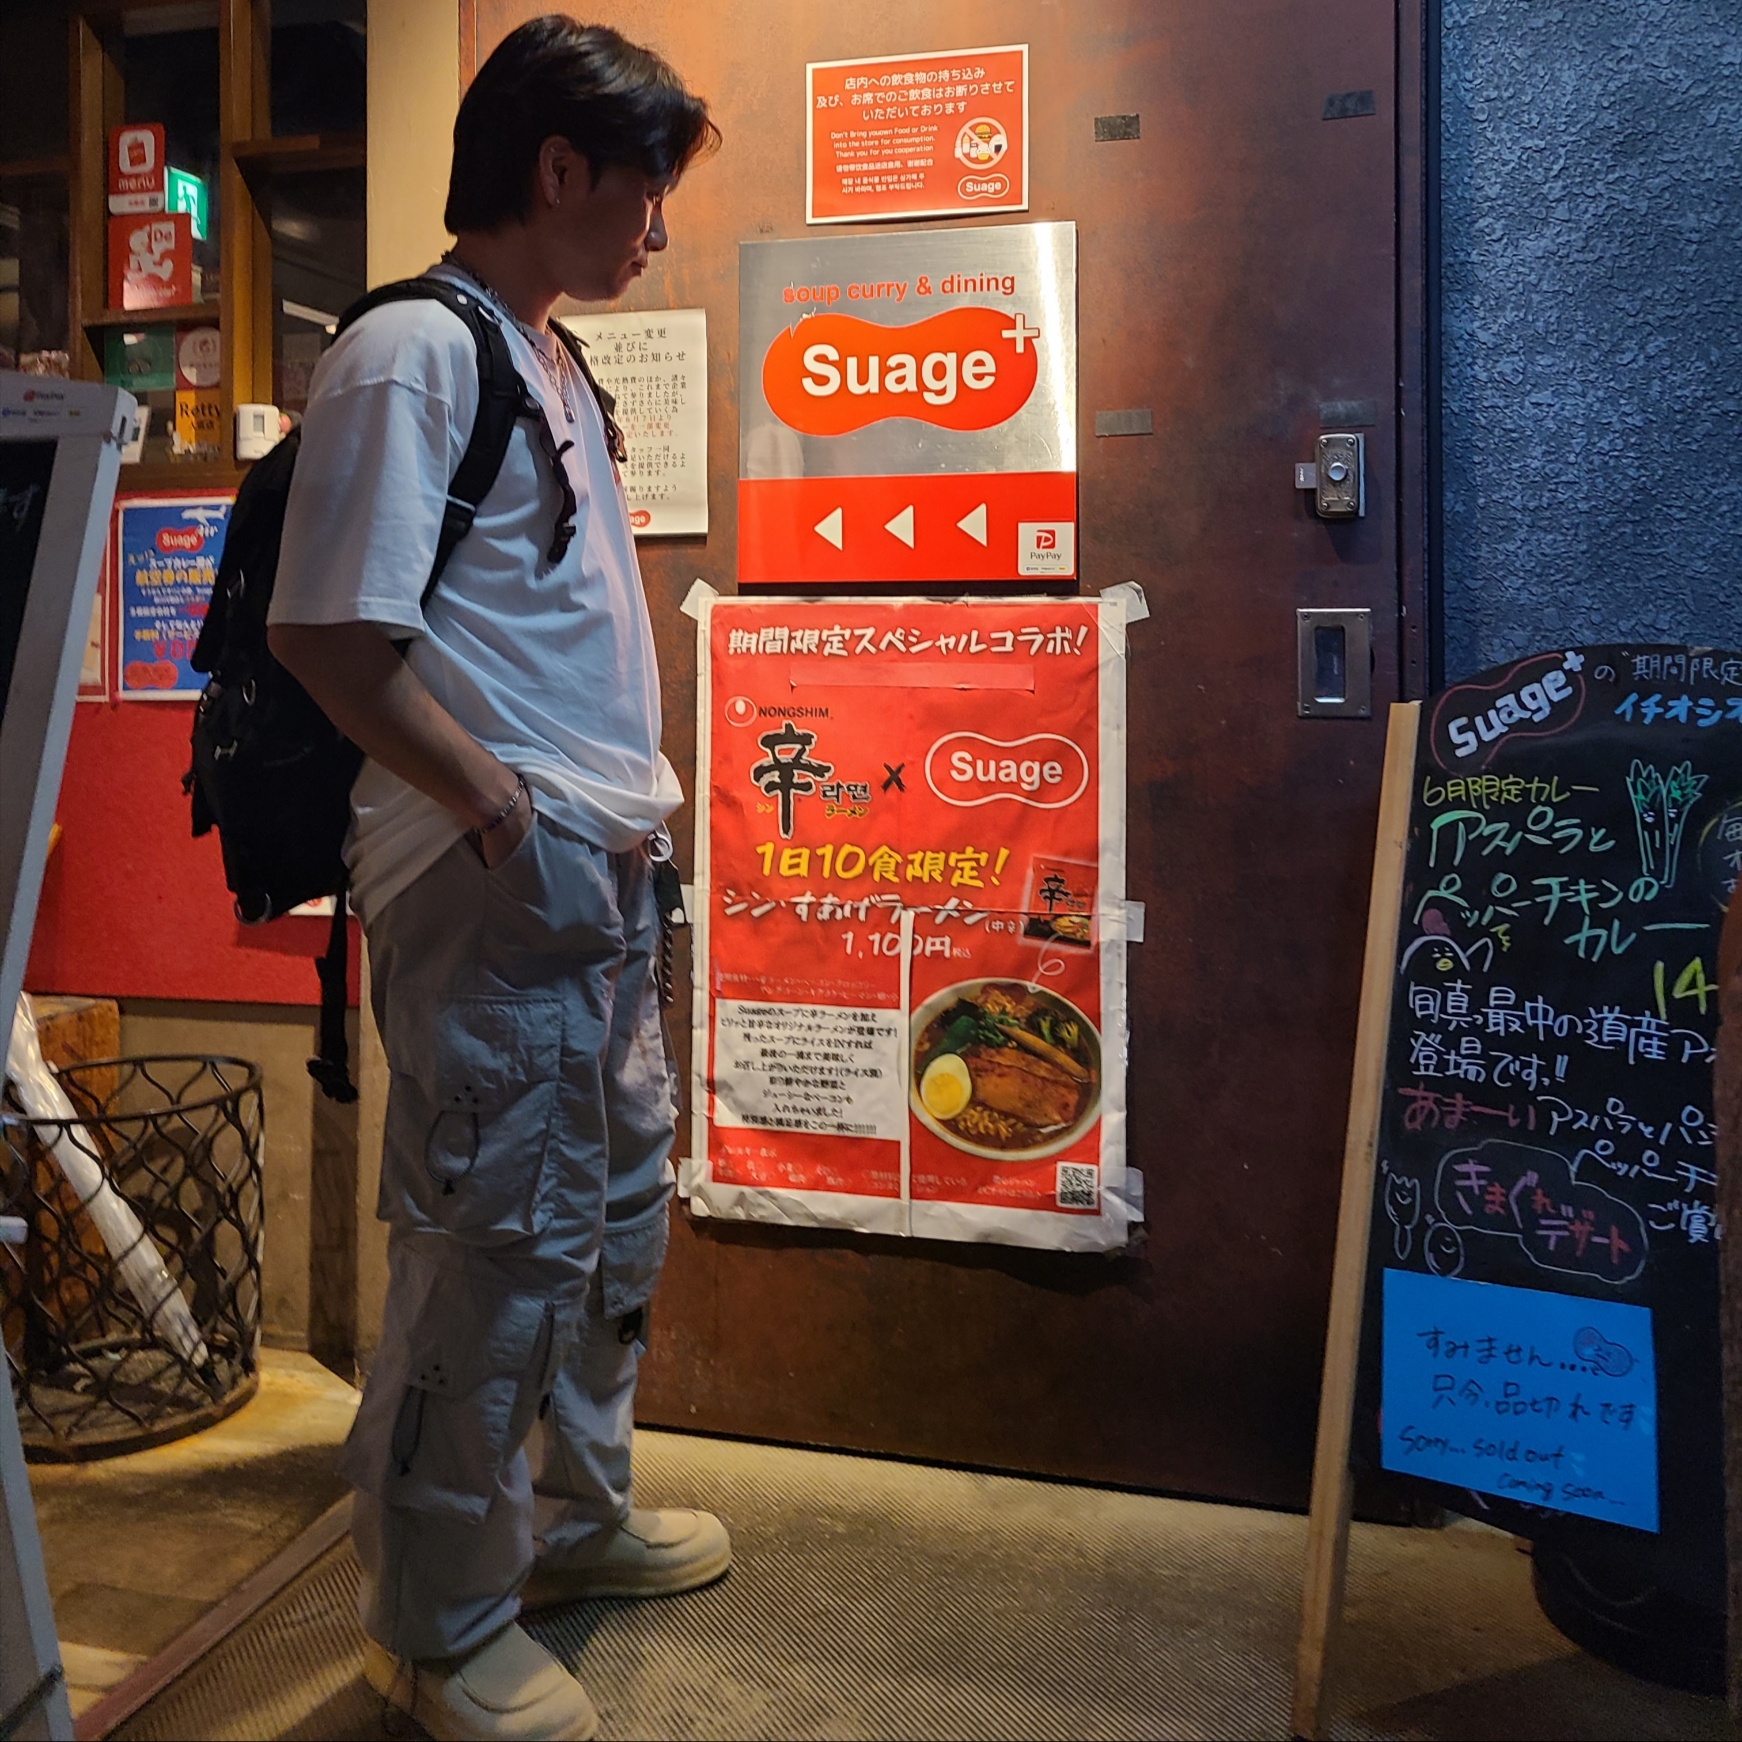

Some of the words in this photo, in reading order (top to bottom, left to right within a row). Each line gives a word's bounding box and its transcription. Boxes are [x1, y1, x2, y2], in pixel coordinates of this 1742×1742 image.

[845, 67, 986, 90] 店内への飲食物の持ち込み
[816, 81, 1016, 109] 及び、お席でのご飲食はお断りさせて
[862, 101, 968, 121] いただいております
[833, 141, 847, 149] into
[861, 139, 879, 147] store
[892, 135, 935, 145] consumption.
[850, 130, 867, 138] Bring
[894, 127, 910, 135] Food
[836, 150, 854, 158] Thank
[856, 150, 868, 158] you
[870, 148, 880, 156] for
[881, 147, 893, 156] you
[894, 145, 934, 155] cooperation
[118, 176, 155, 192] menu
[965, 180, 1002, 195] Suage
[782, 284, 841, 305] soup
[847, 280, 908, 302] curry
[916, 275, 932, 296] &
[941, 271, 1016, 296] dining
[595, 327, 667, 342] メニュー変更
[614, 341, 648, 354] 並びに
[1030, 551, 1062, 562] PayPay
[728, 624, 1089, 658] 期間限定スペシャルコラボ!
[758, 705, 830, 720] NONGSHIM
[750, 720, 834, 839] 辛
[949, 750, 1063, 791] Suage
[819, 780, 871, 804] 라면
[1422, 774, 1600, 810] 6月限定カレー
[1429, 805, 1617, 868] アスパラと
[756, 841, 1011, 888] 1日10食限定!
[1564, 915, 1711, 962] カレー
